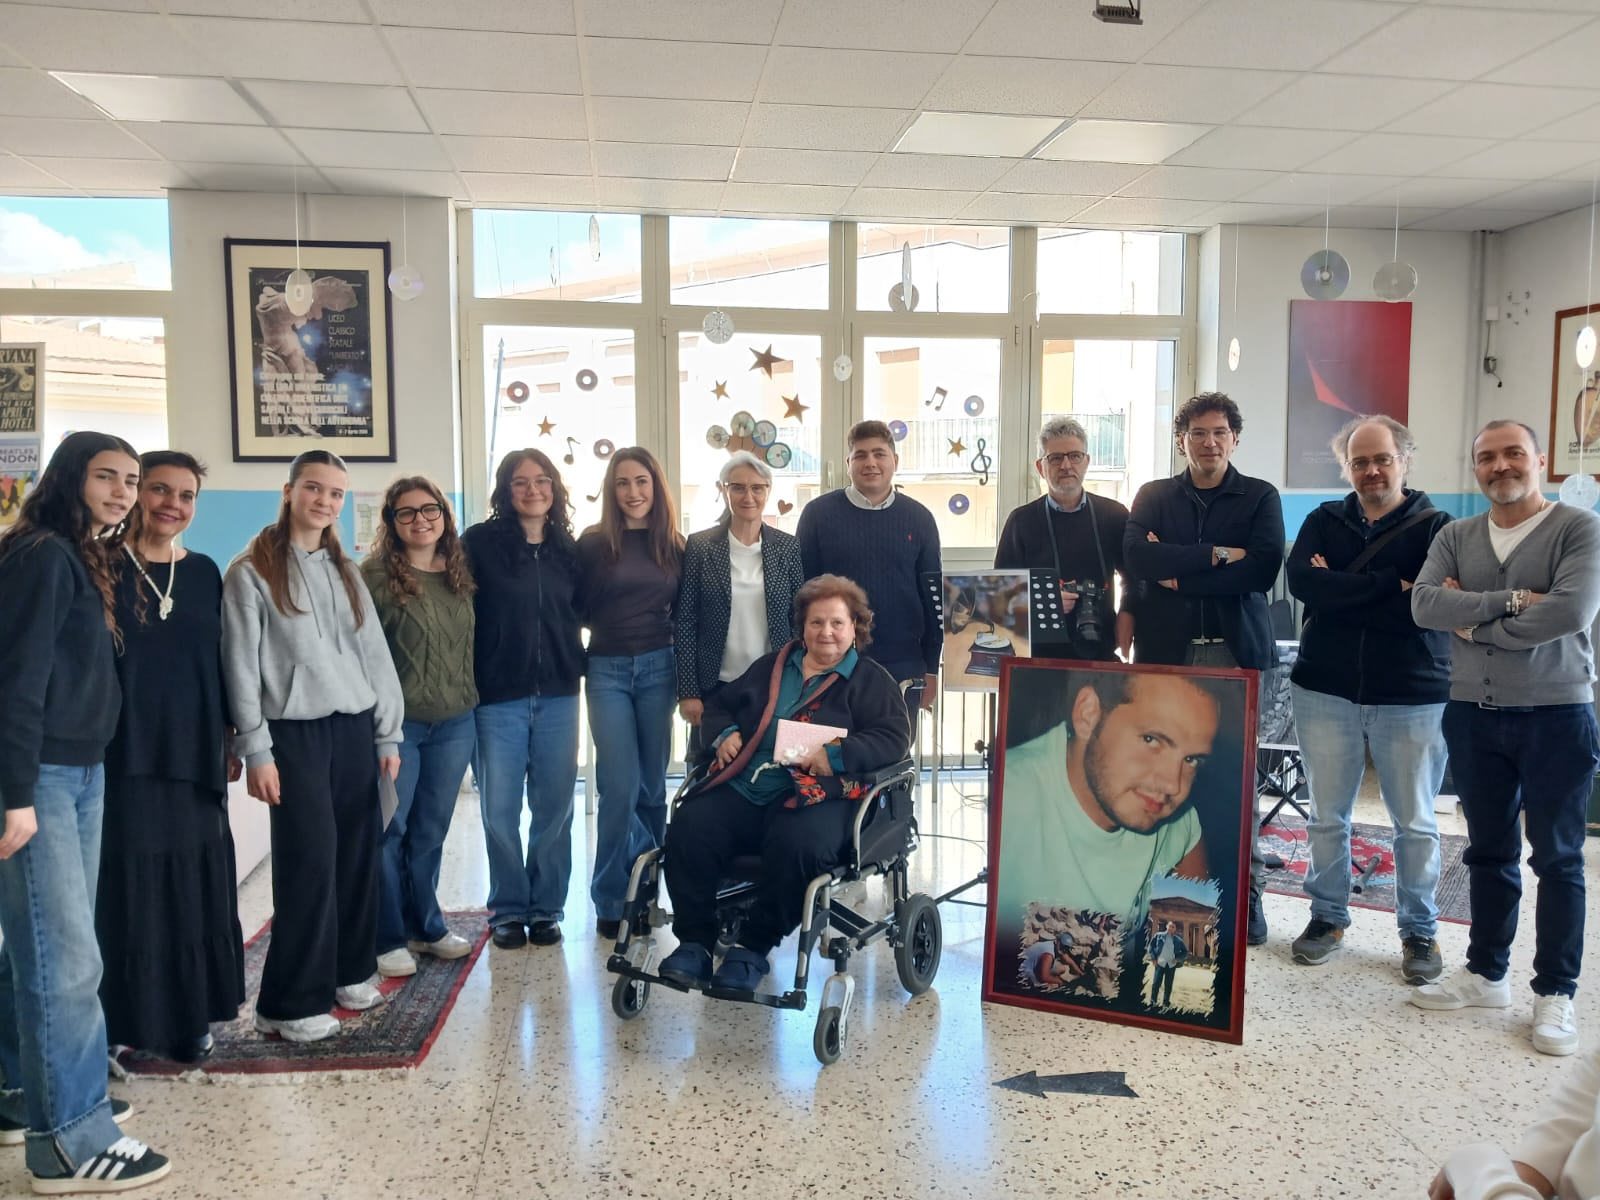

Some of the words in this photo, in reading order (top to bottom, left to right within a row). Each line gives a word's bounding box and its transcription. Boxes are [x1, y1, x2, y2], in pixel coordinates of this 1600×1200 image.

[1, 407, 23, 418] APRIL
[1, 418, 33, 430] HOTEL
[0, 454, 37, 464] NDON
